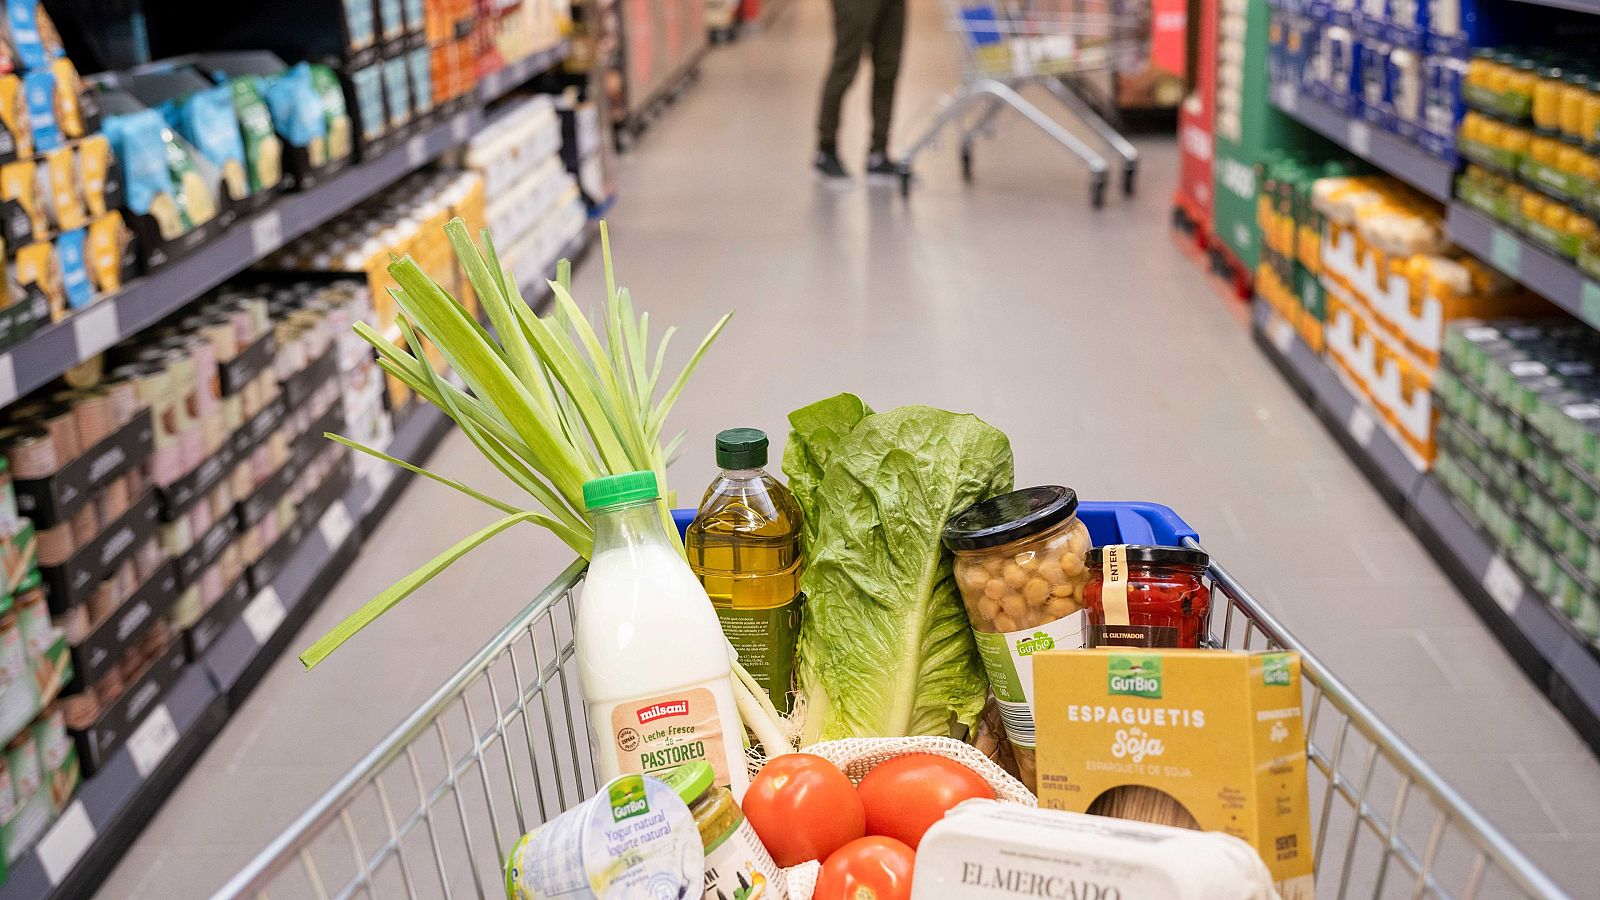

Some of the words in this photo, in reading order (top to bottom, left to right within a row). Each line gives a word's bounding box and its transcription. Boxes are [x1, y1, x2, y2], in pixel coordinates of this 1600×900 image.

[1109, 632, 1144, 640] CULTIVADOR
[640, 701, 687, 721] milsani
[1068, 704, 1205, 728] ESPAGUETIS
[642, 730, 666, 744] Leche
[668, 725, 695, 736] Fresca
[664, 737, 674, 746] de
[1111, 729, 1164, 763] Soja
[641, 740, 705, 770] PASTOREO
[1164, 766, 1192, 778] SOJA
[605, 825, 632, 842] Yogur
[634, 808, 666, 832] natural
[606, 838, 639, 857] Iogurte
[640, 821, 672, 844] natural
[961, 862, 988, 888] EL
[991, 867, 1121, 900] MERCADO
